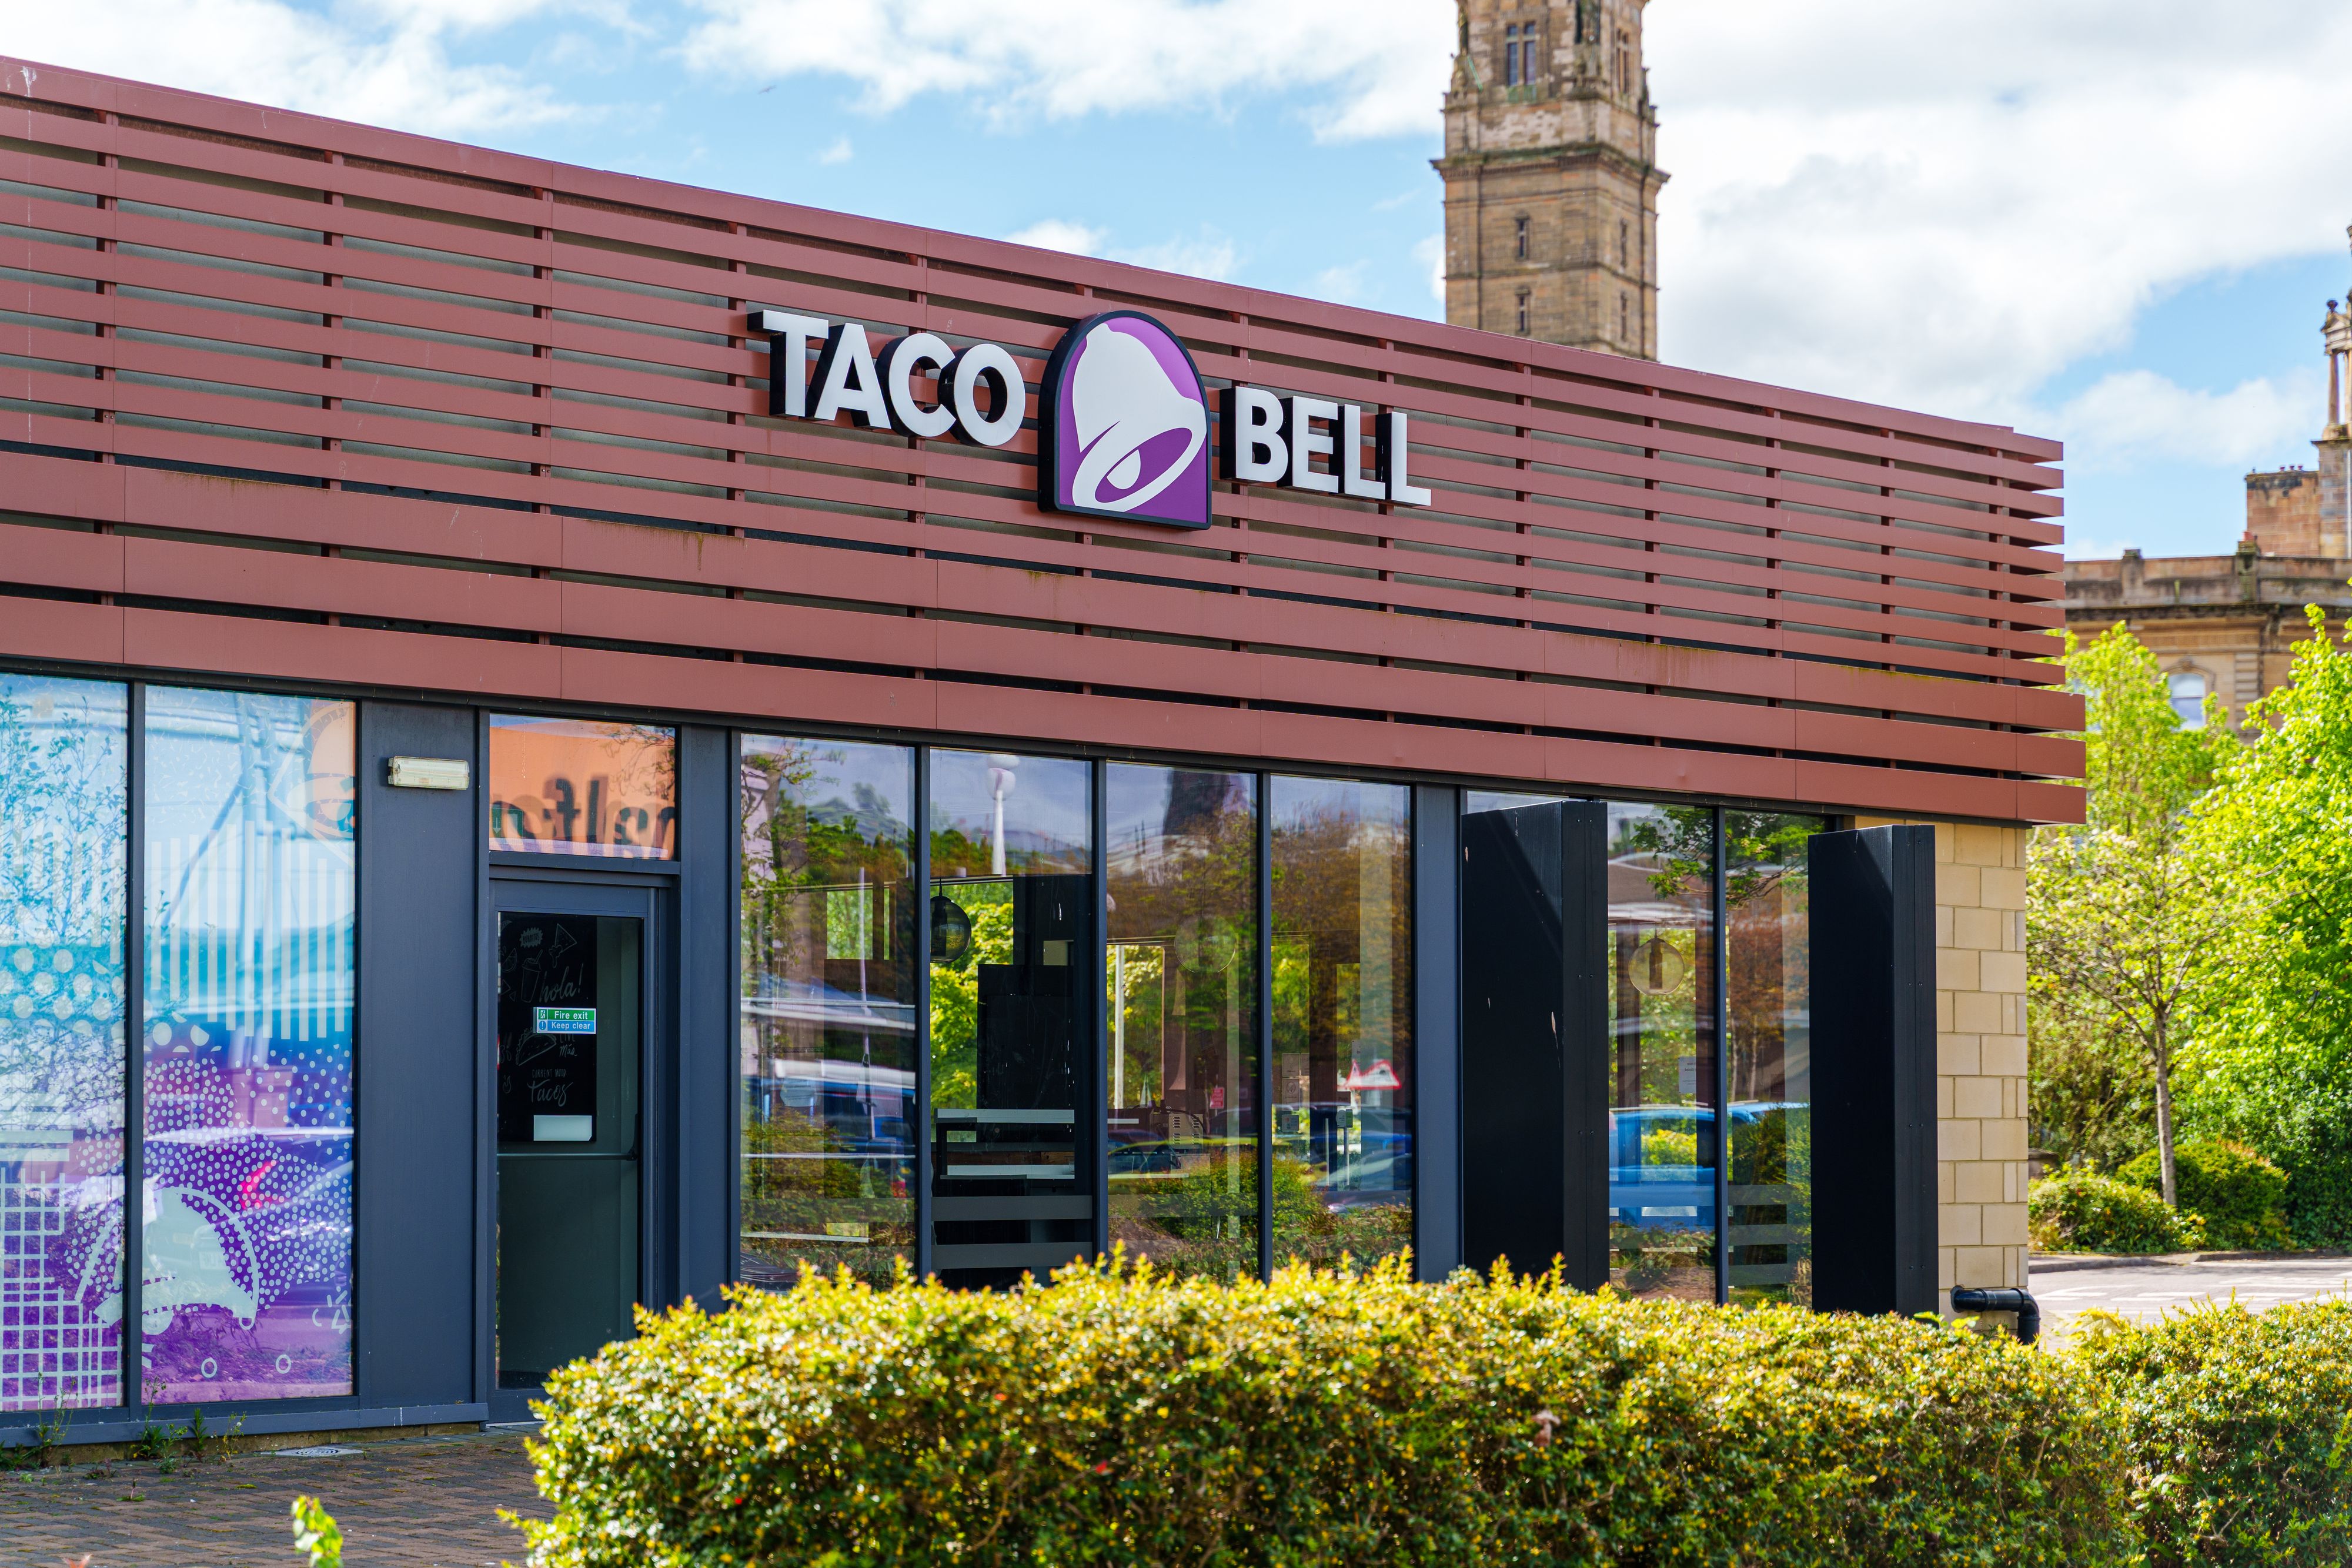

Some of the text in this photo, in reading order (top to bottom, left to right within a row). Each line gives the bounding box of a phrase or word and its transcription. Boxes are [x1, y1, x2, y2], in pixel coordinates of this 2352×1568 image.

[760, 309, 1432, 507] TACO BELL
[554, 1011, 588, 1019] Fire exit
[552, 1021, 570, 1031] Keep
[532, 1068, 553, 1078] CURRENT
